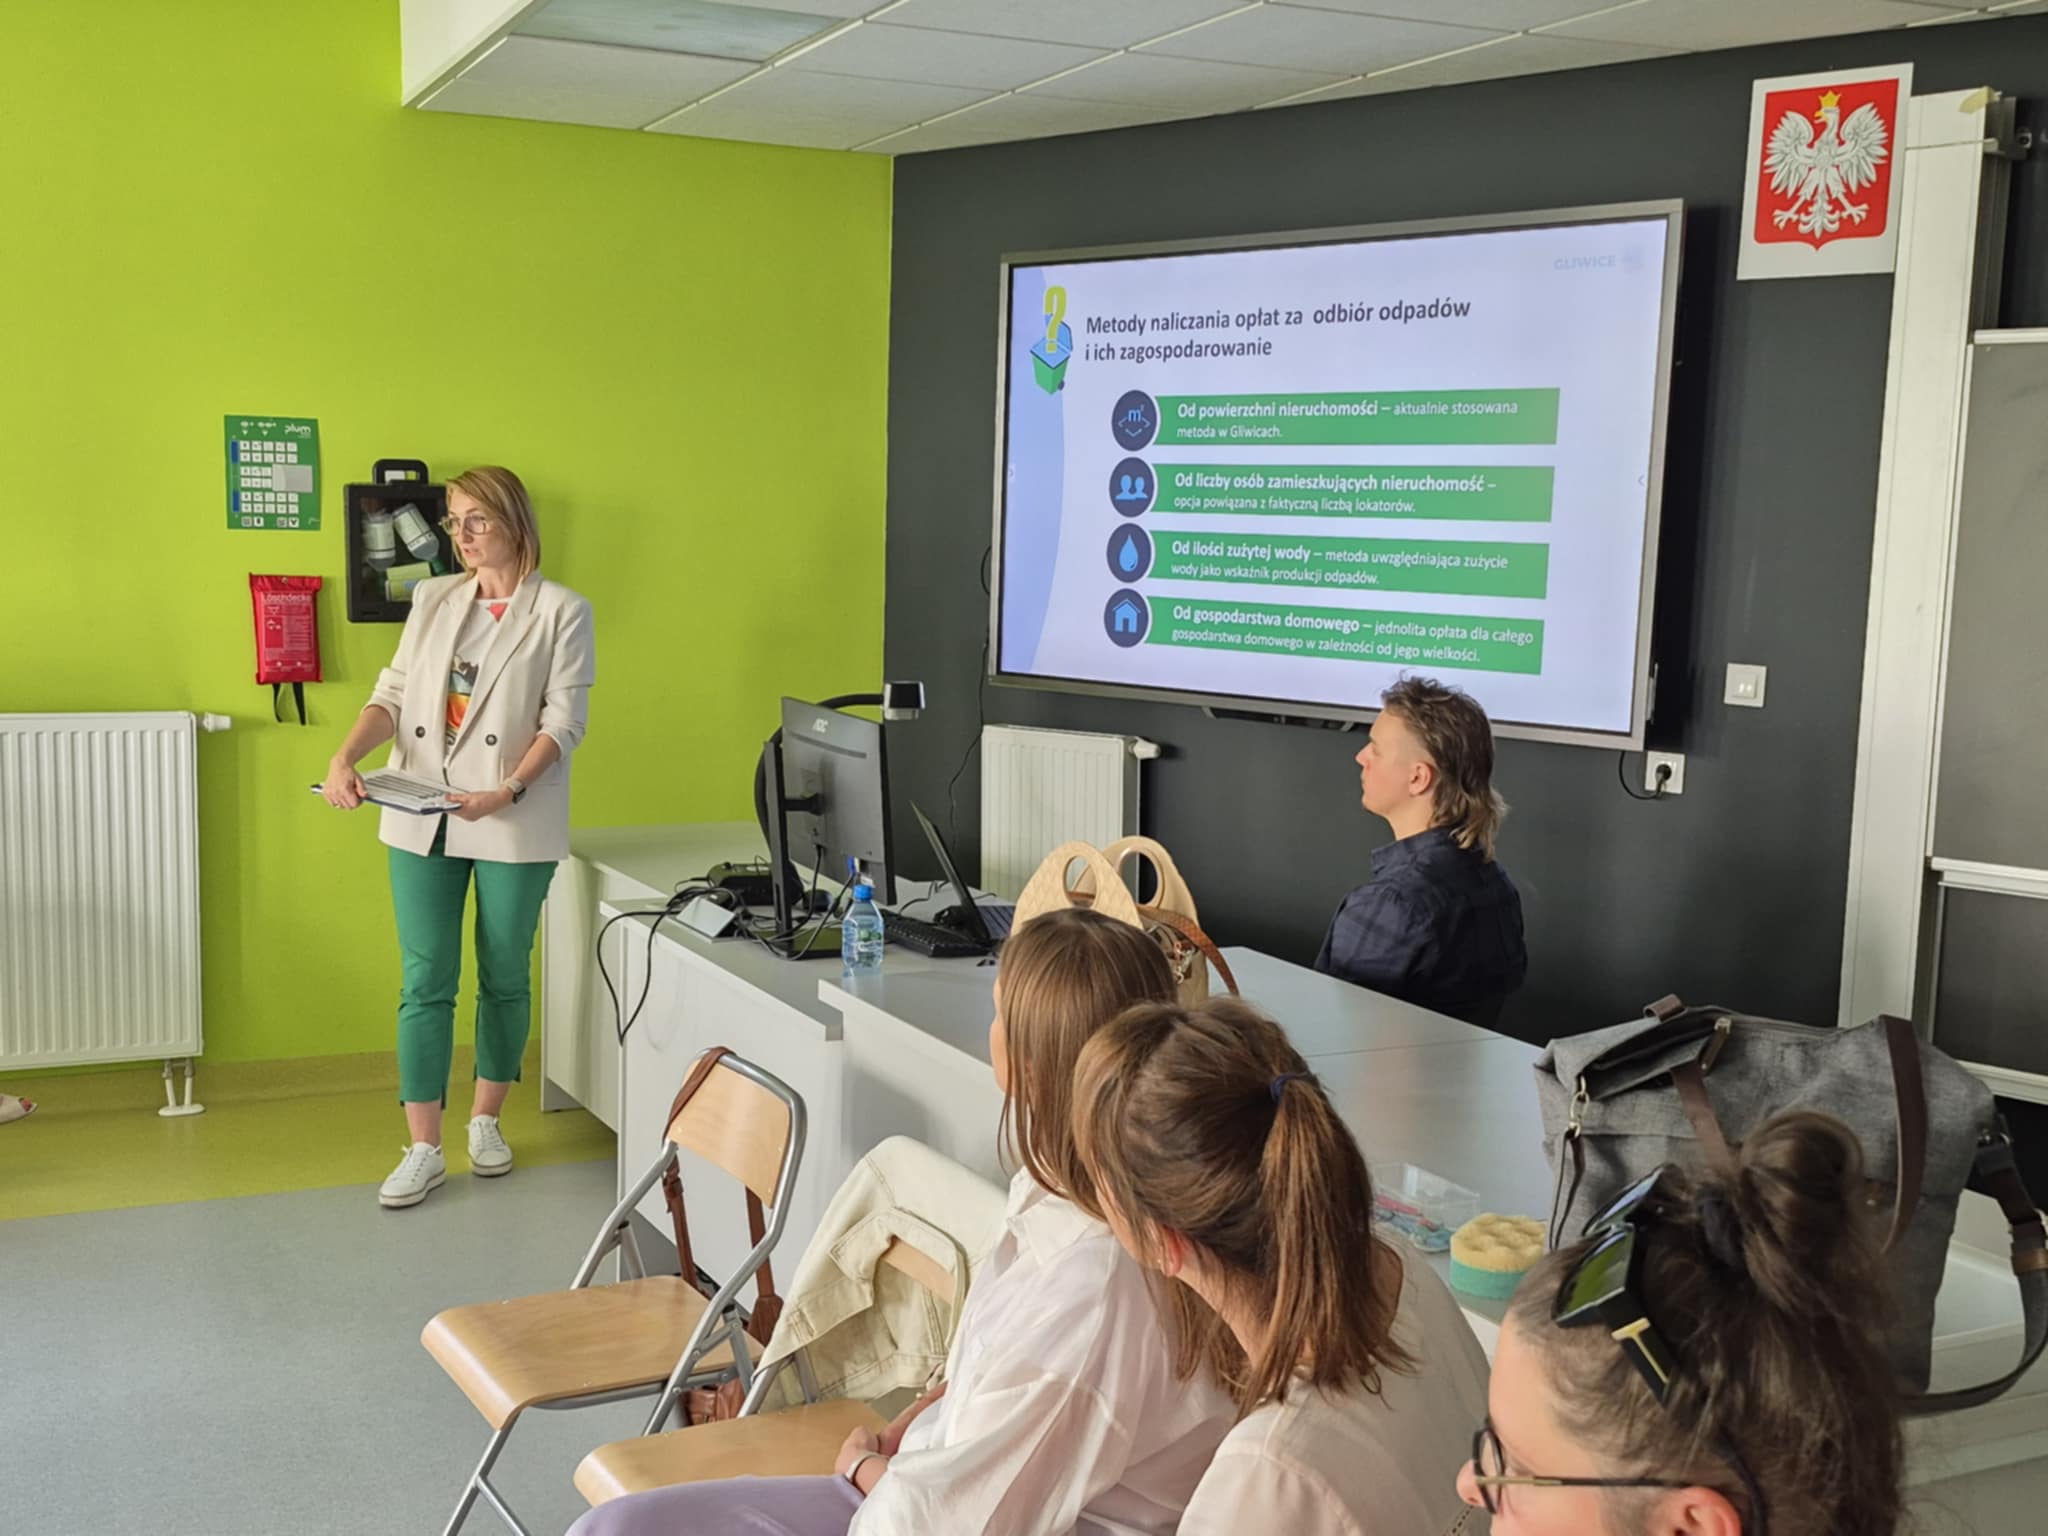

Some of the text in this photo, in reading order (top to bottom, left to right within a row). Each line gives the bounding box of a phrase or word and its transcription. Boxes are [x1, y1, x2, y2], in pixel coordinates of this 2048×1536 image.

[1554, 255, 1616, 270] GLIWICE
[1086, 297, 1471, 336] Metody naliczania opłat za odbiór odpadów
[1085, 337, 1272, 364] i ich zagospodarowanie
[1178, 403, 1195, 418] Od
[1199, 402, 1275, 420] powierzchni
[1279, 400, 1378, 417] nieruchomości
[1394, 401, 1449, 416] aktualnie
[1451, 401, 1518, 415] stosowana
[1177, 425, 1283, 438] metoda w Gliwicach.
[1175, 473, 1193, 487] Od
[1196, 473, 1231, 491] liczby
[1233, 473, 1264, 488] osób
[1268, 474, 1377, 494] zamieszkujących
[1382, 474, 1485, 492] nieruchomość
[1174, 495, 1416, 513] opcja powiązana z faktyczną liczbą lokatorów.
[1172, 541, 1189, 555] Od
[1193, 540, 1224, 556] ilości
[1227, 543, 1271, 561] zużytej
[1275, 546, 1310, 563] wody
[1325, 551, 1368, 563] metoda
[1372, 552, 1461, 569] uwzględniająca
[1464, 554, 1508, 571] zużycie
[1171, 564, 1379, 585] wody jako wskaźnik produkcji odpadów.
[1173, 605, 1191, 620] Od
[1193, 607, 1281, 627] gospodarstwa
[1284, 612, 1360, 634] domowego
[1374, 620, 1426, 638] jednolita
[1429, 625, 1467, 641] opłata
[1471, 626, 1488, 641] dla
[1492, 629, 1533, 646] całego
[1171, 628, 1481, 663] gospodarstwa domowego w zależności od jego wielkości.
